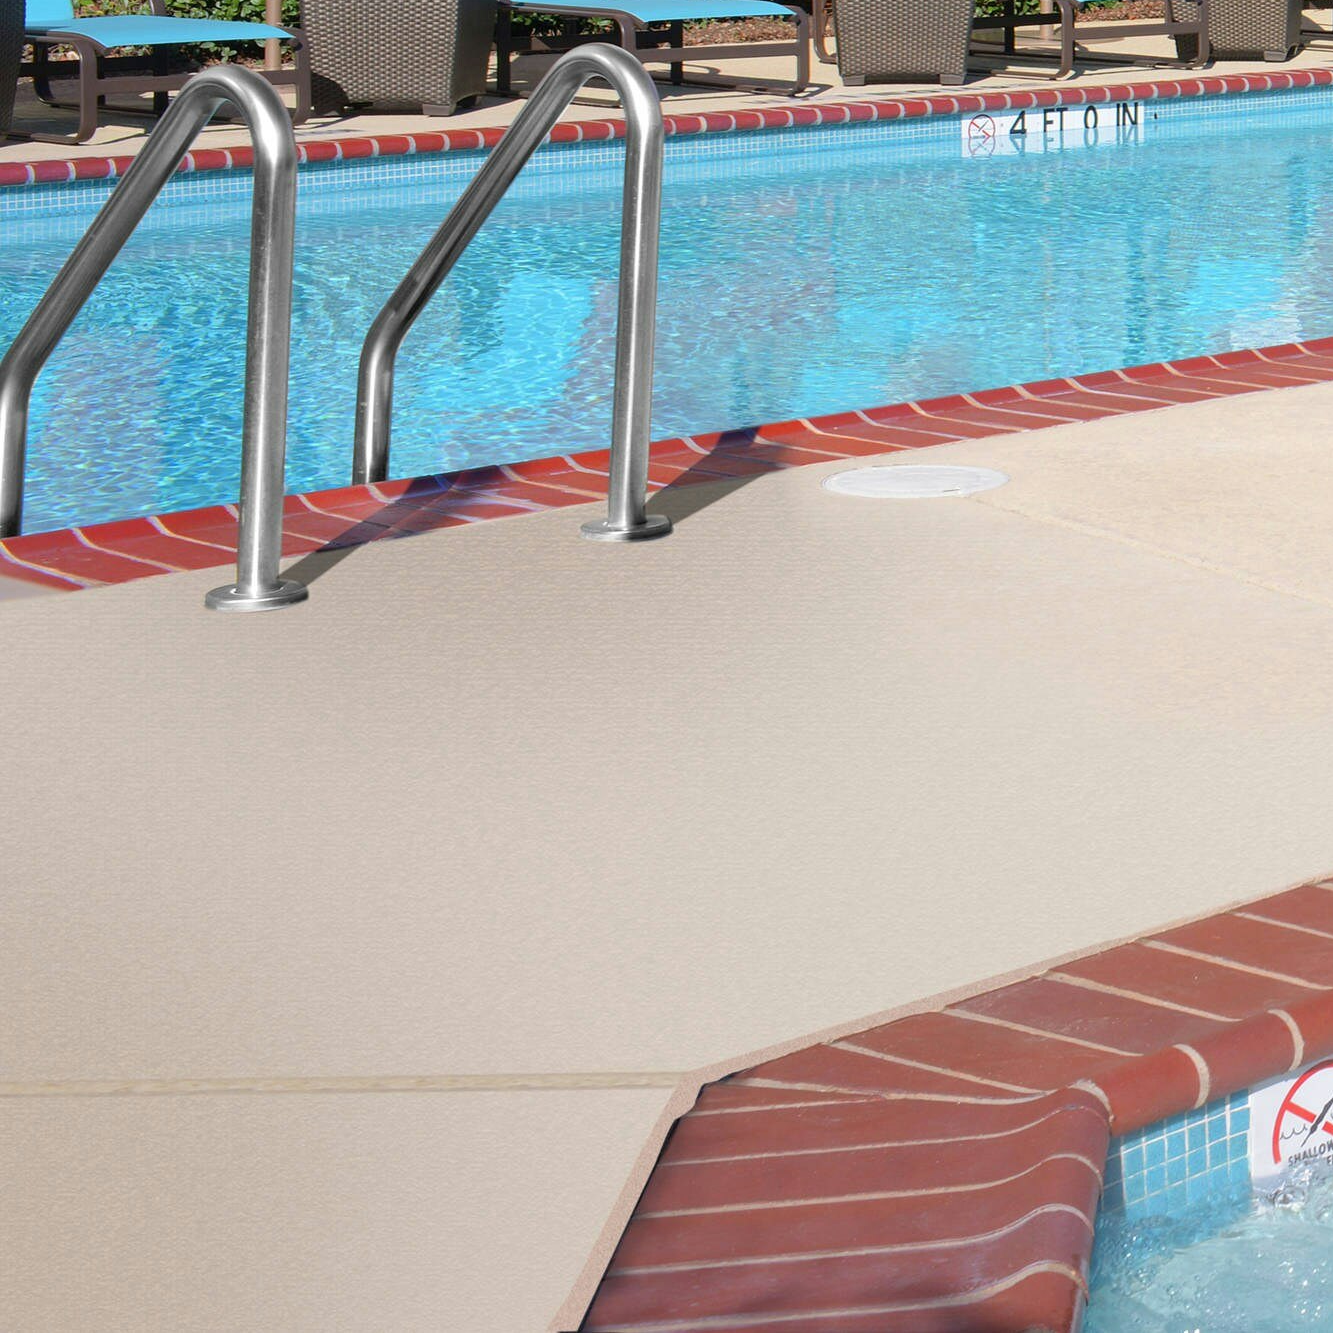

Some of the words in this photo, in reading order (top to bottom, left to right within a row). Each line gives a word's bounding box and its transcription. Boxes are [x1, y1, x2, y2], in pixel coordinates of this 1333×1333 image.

[1010, 110, 1027, 134] 4
[1043, 107, 1069, 132] FT
[1116, 102, 1139, 126] IN
